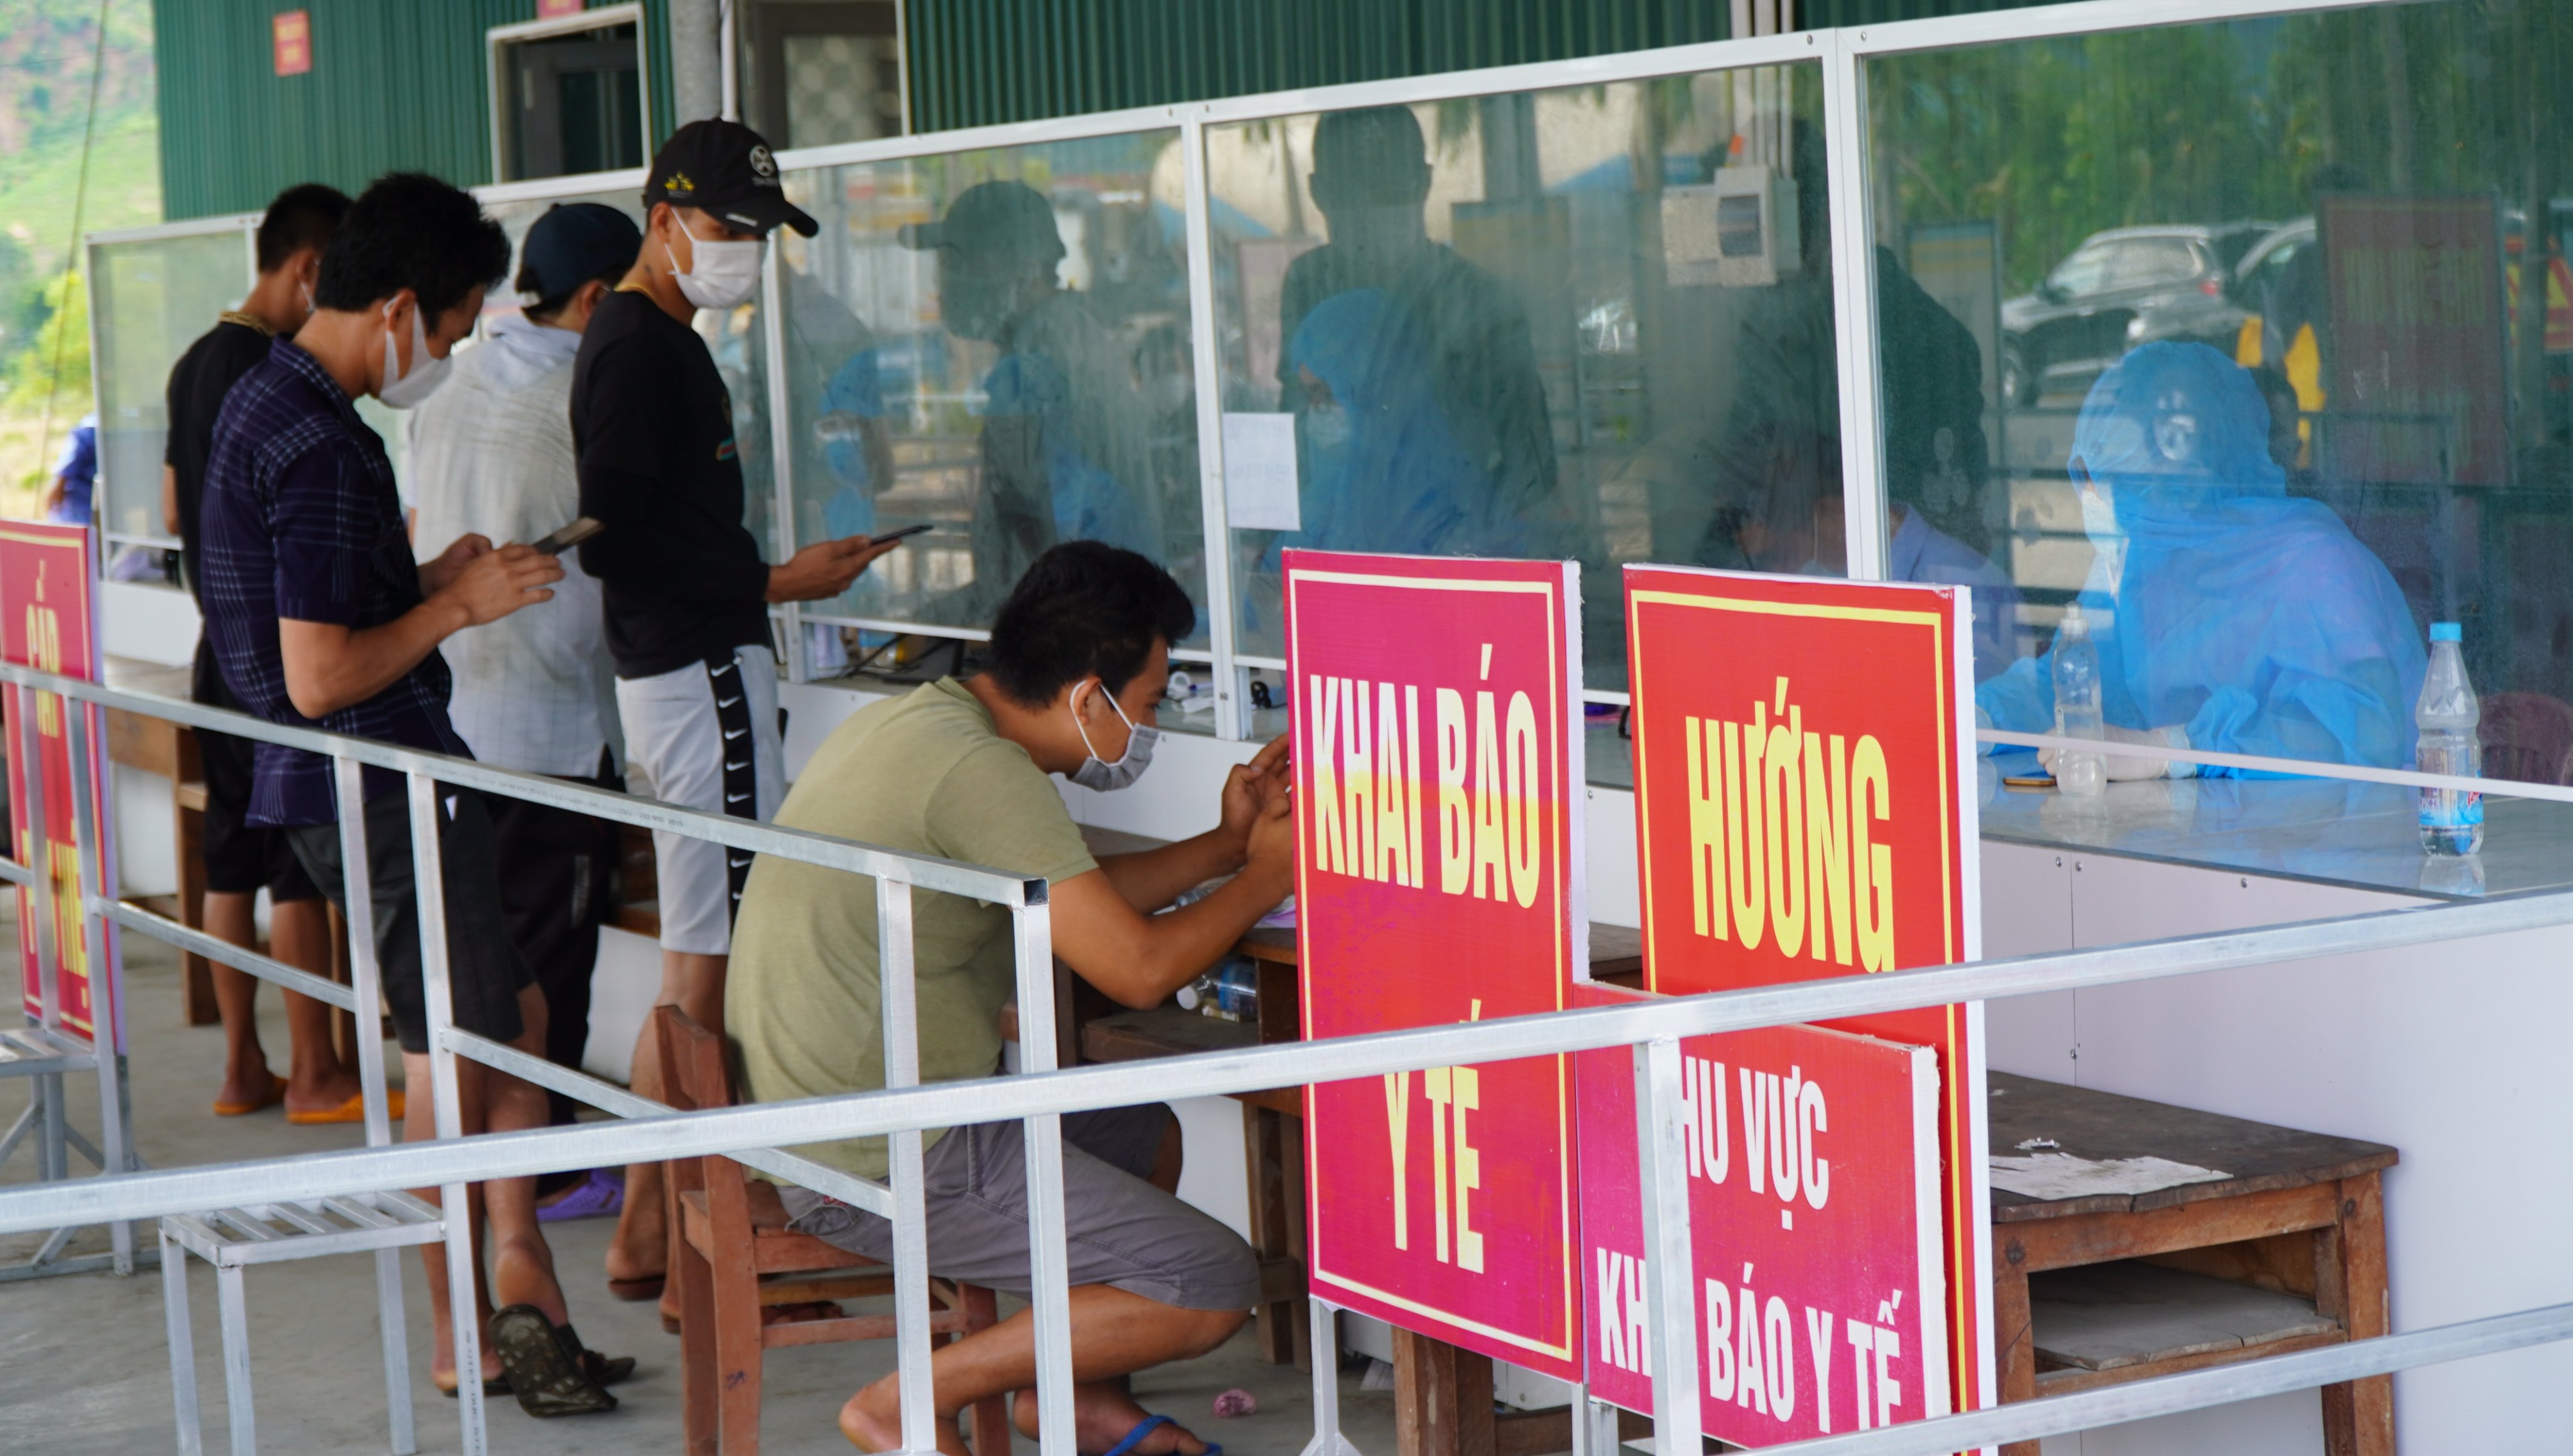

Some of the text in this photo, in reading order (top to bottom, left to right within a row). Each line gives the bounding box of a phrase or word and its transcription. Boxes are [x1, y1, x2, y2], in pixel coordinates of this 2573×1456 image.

[1310, 643, 1540, 909] KHAI BÁO
[1686, 676, 1896, 974] HƯỚNG
[1384, 1070, 1410, 1251] Y
[1681, 1055, 1830, 1231] HU VỰC
[1705, 1262, 1795, 1423] BÁO
[1805, 1306, 1833, 1435] Y
